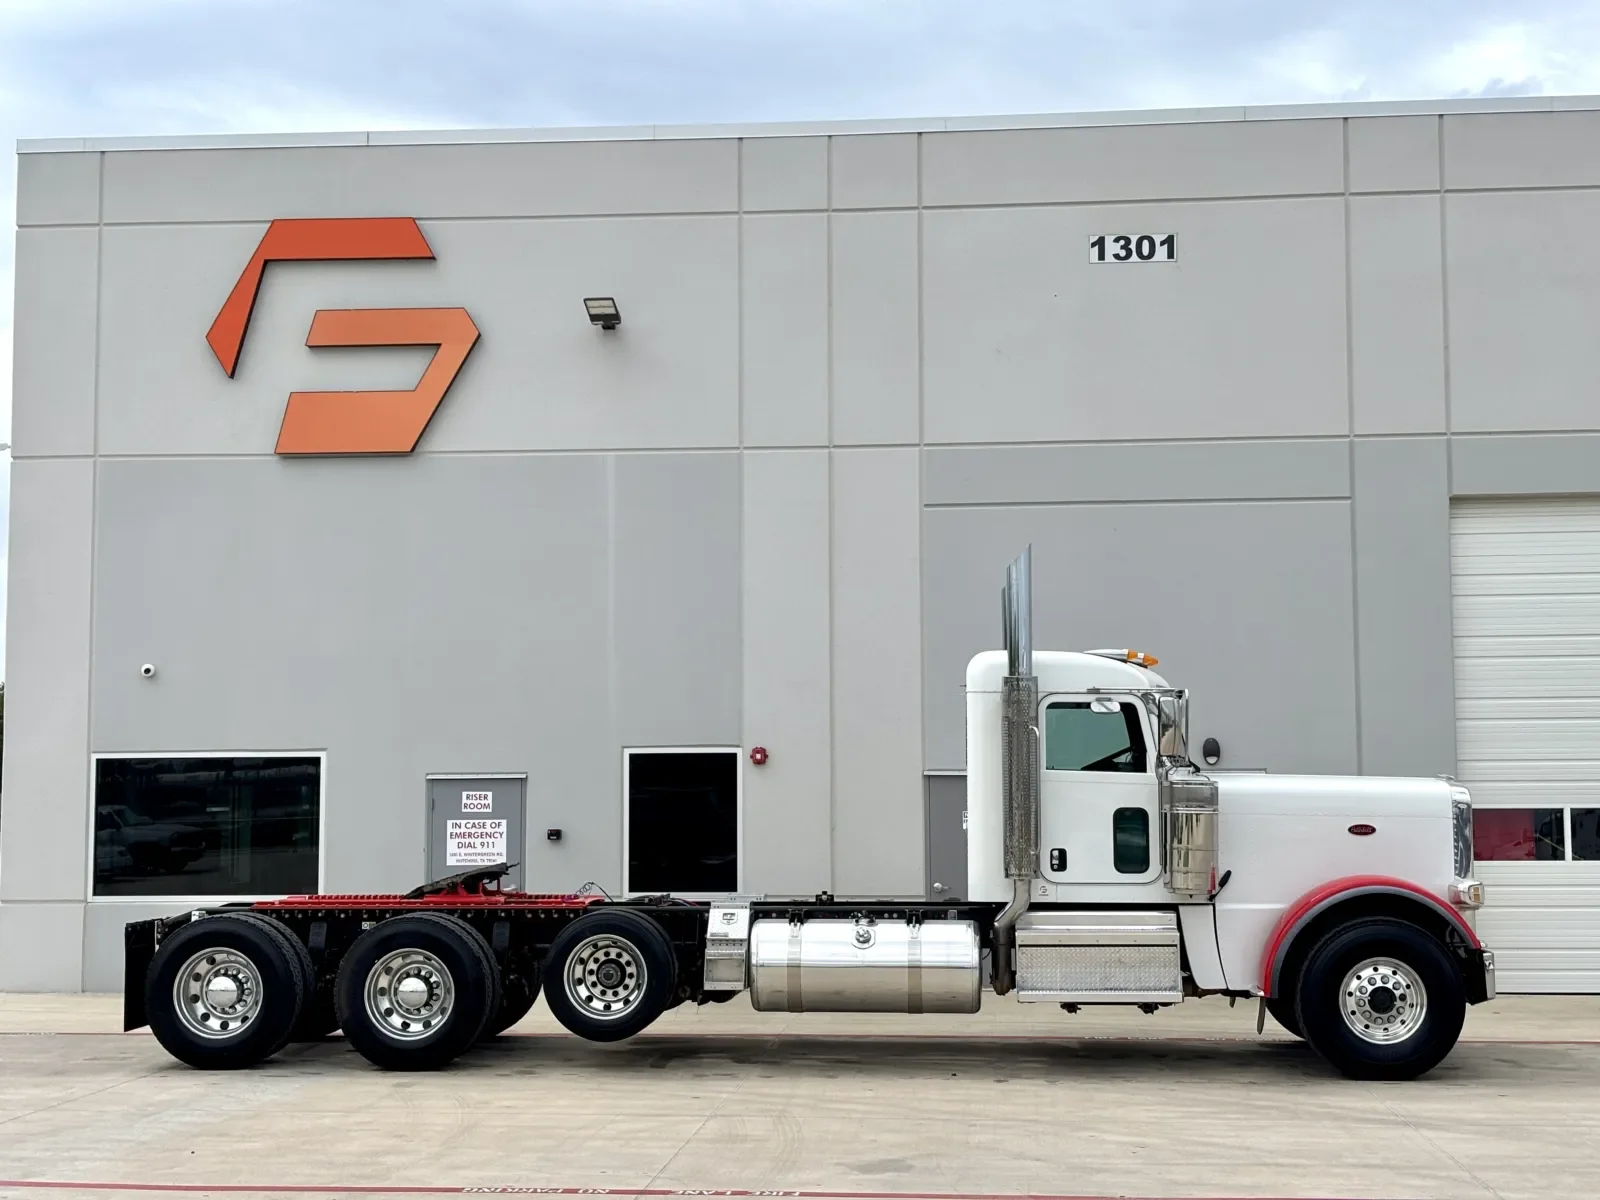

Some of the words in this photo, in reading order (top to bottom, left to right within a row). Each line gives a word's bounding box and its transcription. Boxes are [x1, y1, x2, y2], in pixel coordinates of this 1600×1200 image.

[1090, 234, 1175, 262] 1301
[466, 793, 489, 801] RISER
[463, 802, 491, 810] ROOM
[451, 822, 462, 830] IN
[464, 821, 487, 830] CASE
[489, 821, 503, 830] OF
[449, 831, 504, 840] EMERGENCY
[457, 841, 478, 849] DIAL
[480, 841, 495, 849] 911
